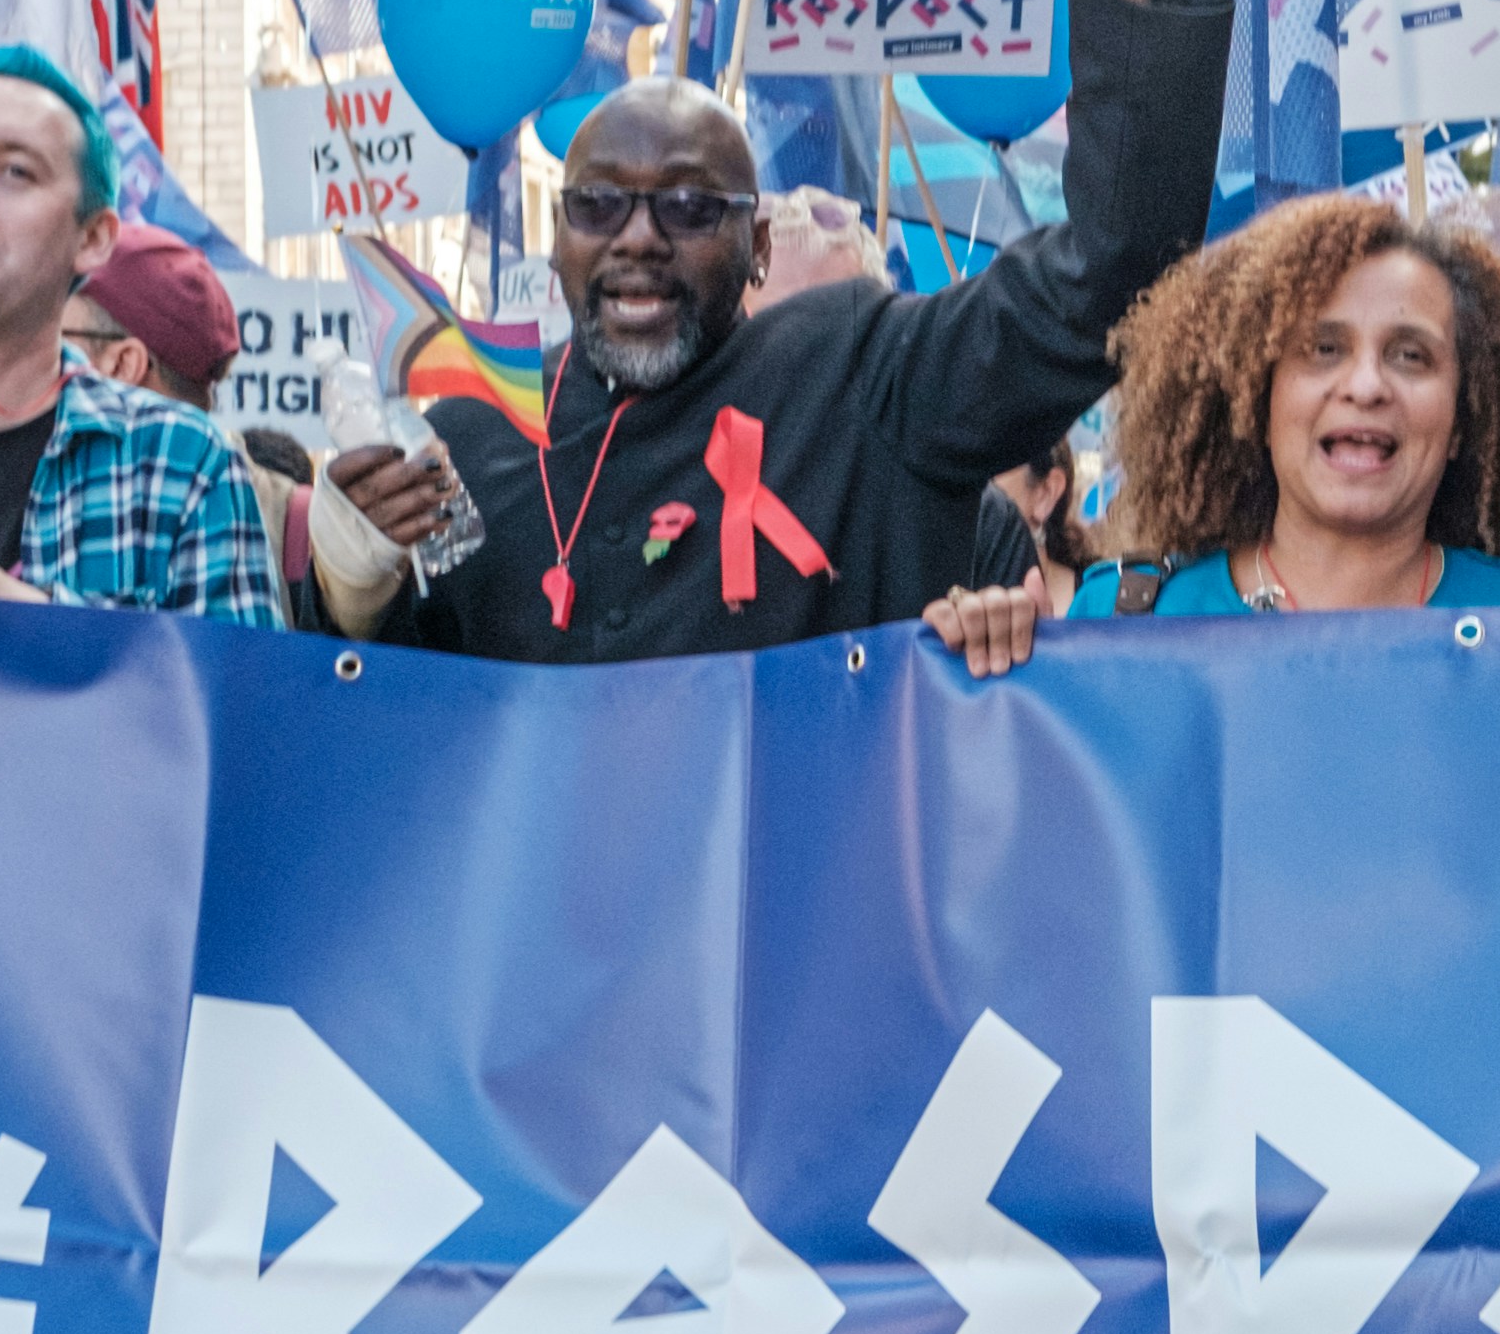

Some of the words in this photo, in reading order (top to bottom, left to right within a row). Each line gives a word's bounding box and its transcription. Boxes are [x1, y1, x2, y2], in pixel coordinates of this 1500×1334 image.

[325, 88, 393, 131] HIV
[311, 144, 340, 174] IS
[355, 132, 416, 166] NOT
[324, 172, 420, 221] AIDS
[238, 307, 274, 356] O
